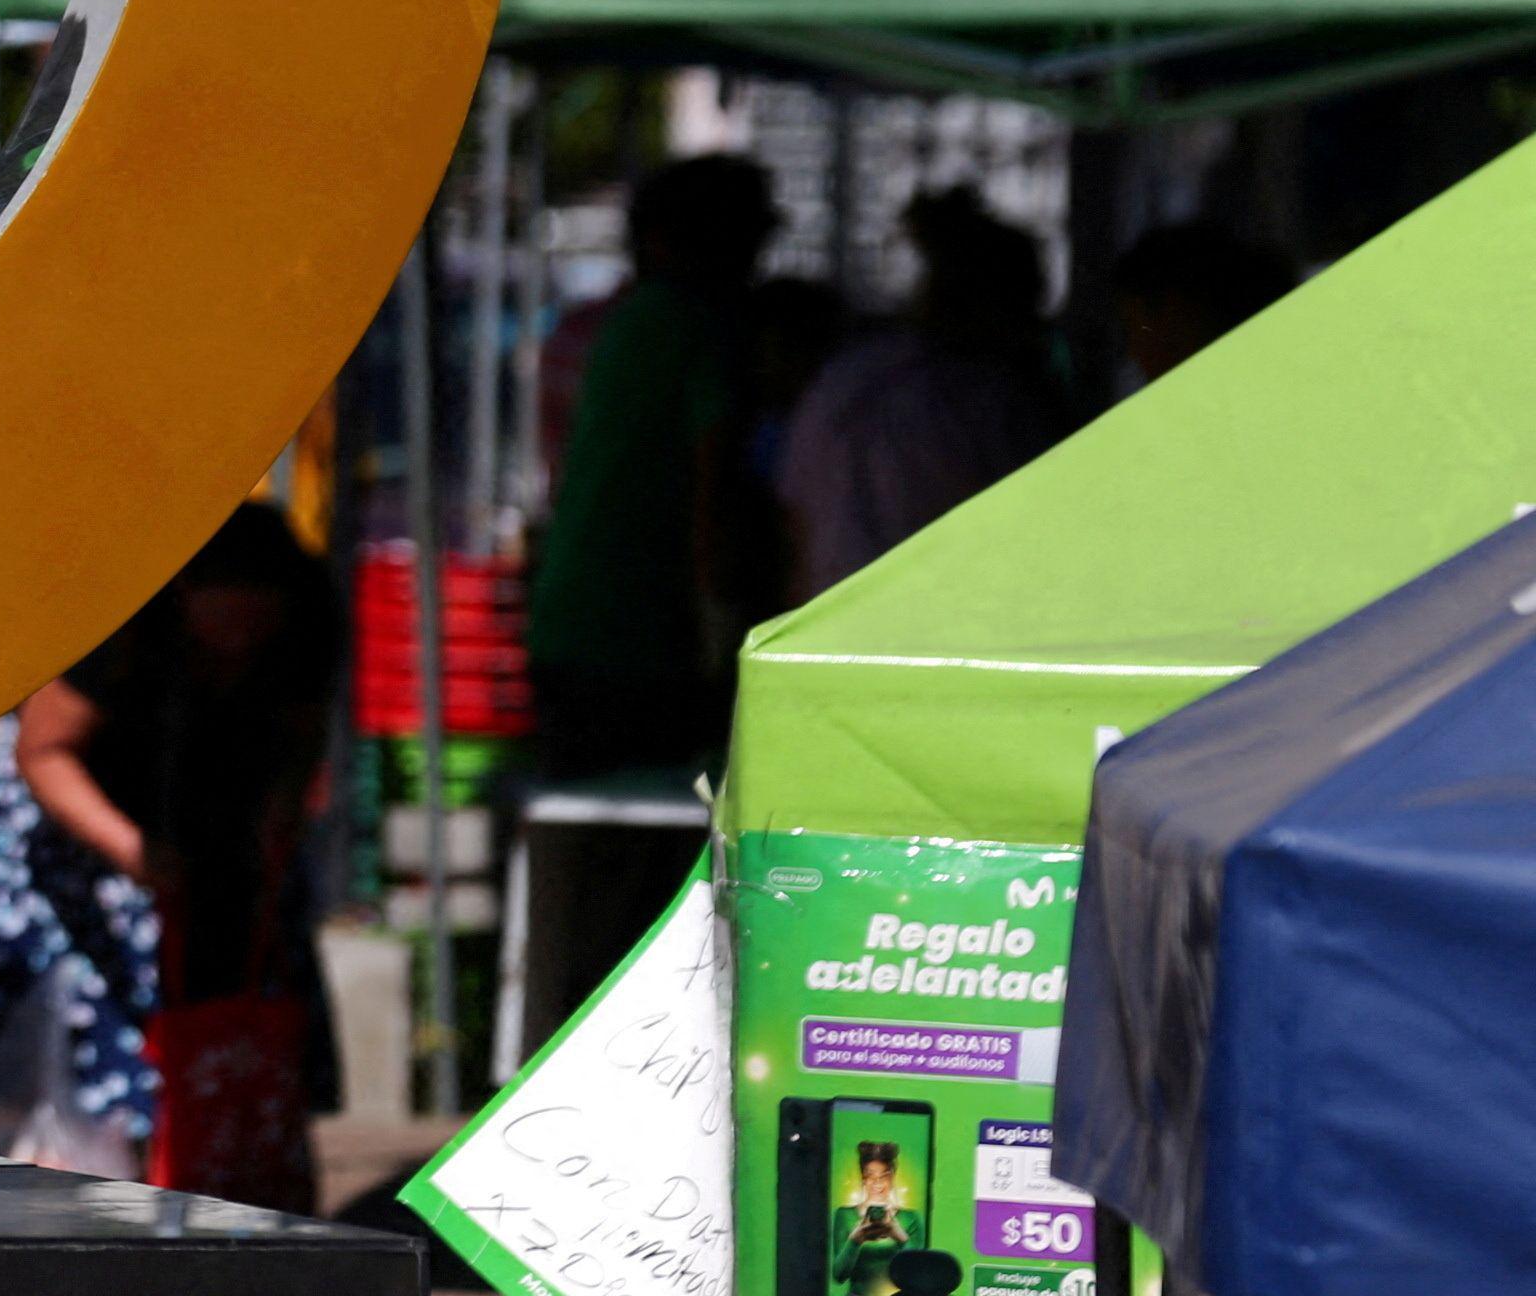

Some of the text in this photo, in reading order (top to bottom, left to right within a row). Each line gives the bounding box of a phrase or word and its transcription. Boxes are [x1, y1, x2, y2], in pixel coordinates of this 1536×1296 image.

[865, 913, 1035, 964] Regalo
[806, 955, 1066, 1003] adelantad
[810, 1027, 1012, 1054] Certificado GRATIS
[816, 1050, 851, 1064] para
[647, 1176, 729, 1245] Dat
[1001, 1212, 1082, 1253] $50
